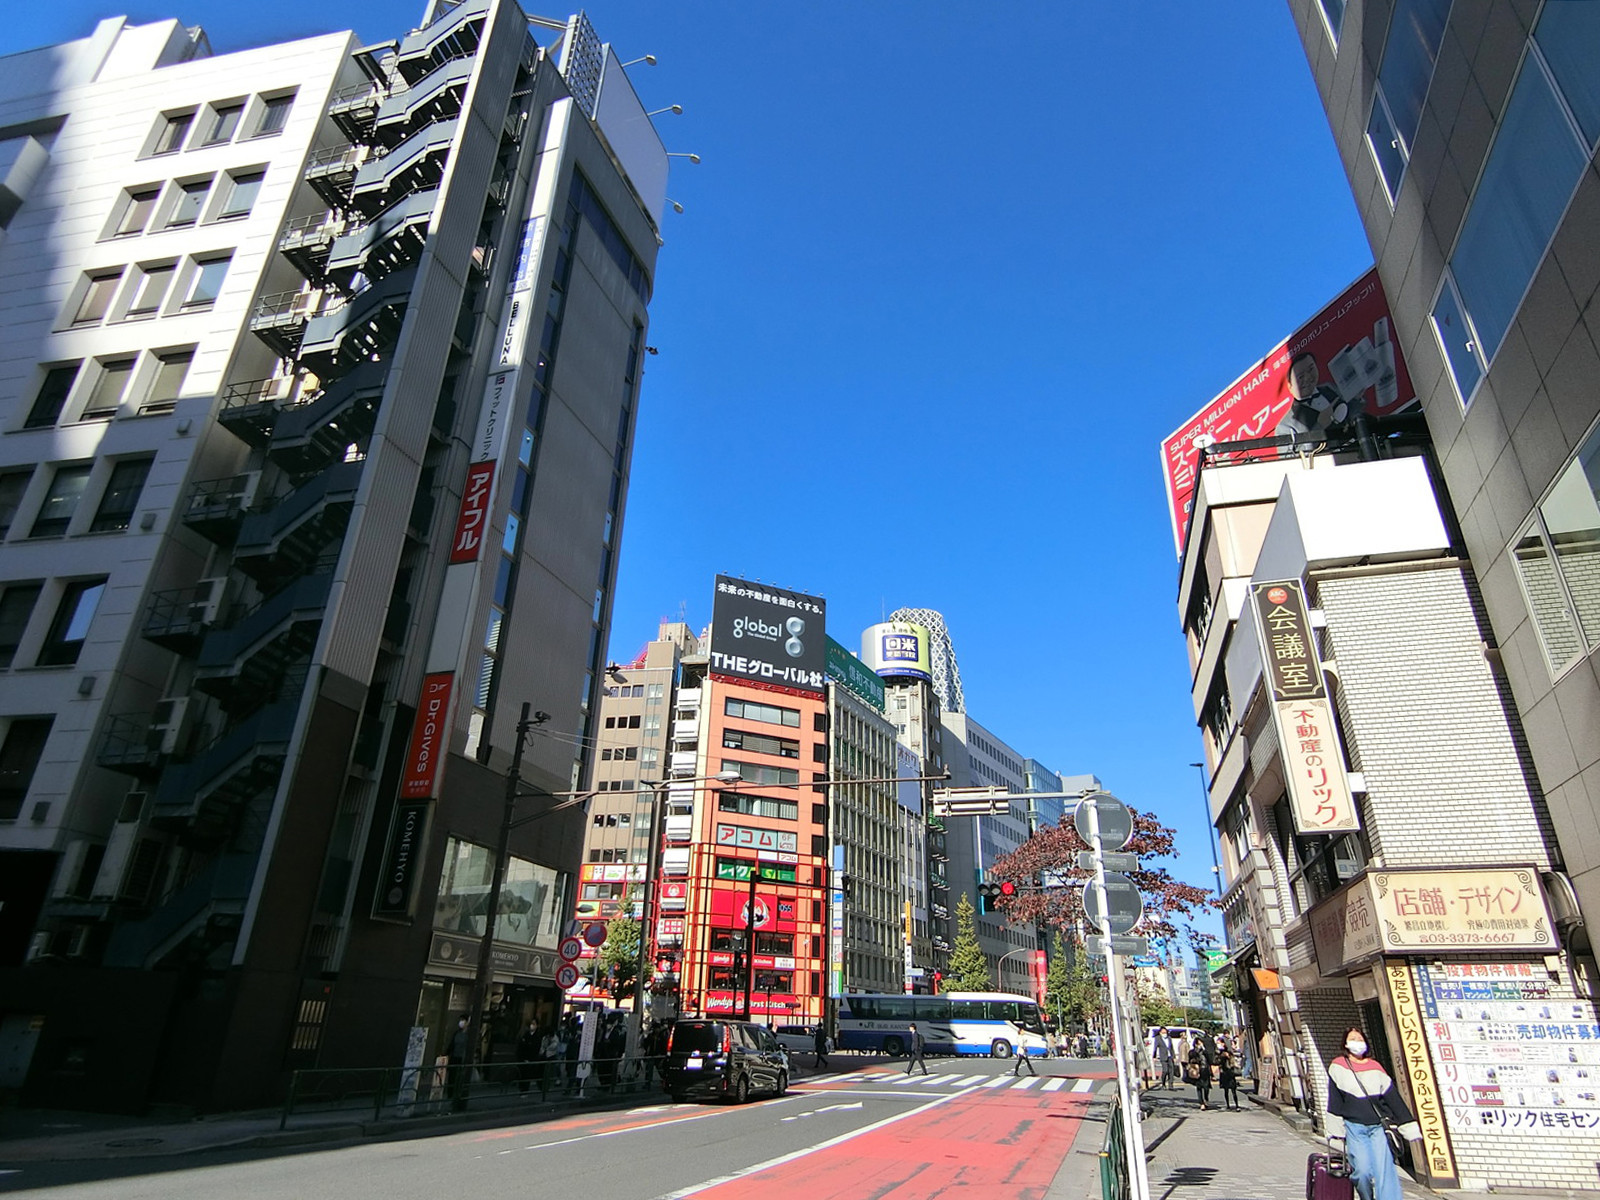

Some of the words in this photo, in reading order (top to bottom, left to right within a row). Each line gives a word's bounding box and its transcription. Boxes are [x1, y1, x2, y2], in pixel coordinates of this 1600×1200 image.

[500, 300, 519, 366] BELLUNA
[1170, 424, 1202, 454] SUPER
[1203, 391, 1242, 428] MILLION
[1243, 368, 1269, 396] HAIR
[457, 472, 490, 551] アイフル
[733, 616, 782, 638] global
[885, 638, 916, 651] 日米
[1267, 605, 1312, 690] 会議室
[711, 651, 823, 687] THEグローバル社
[1292, 709, 1337, 825] 不動産のリック
[395, 811, 417, 883] KOMEHYO
[721, 827, 772, 846] アコム
[780, 854, 797, 862] アコム
[1394, 887, 1522, 917] 店舗・デザイン
[563, 944, 577, 956] 40
[1429, 933, 1516, 943] 03-3373-6667
[1446, 963, 1532, 977] 投資物件情報
[707, 995, 733, 1009] Wendy's
[1441, 991, 1458, 999] ビル
[1391, 965, 1449, 1171] あたらしいカタチのふどうさん屋
